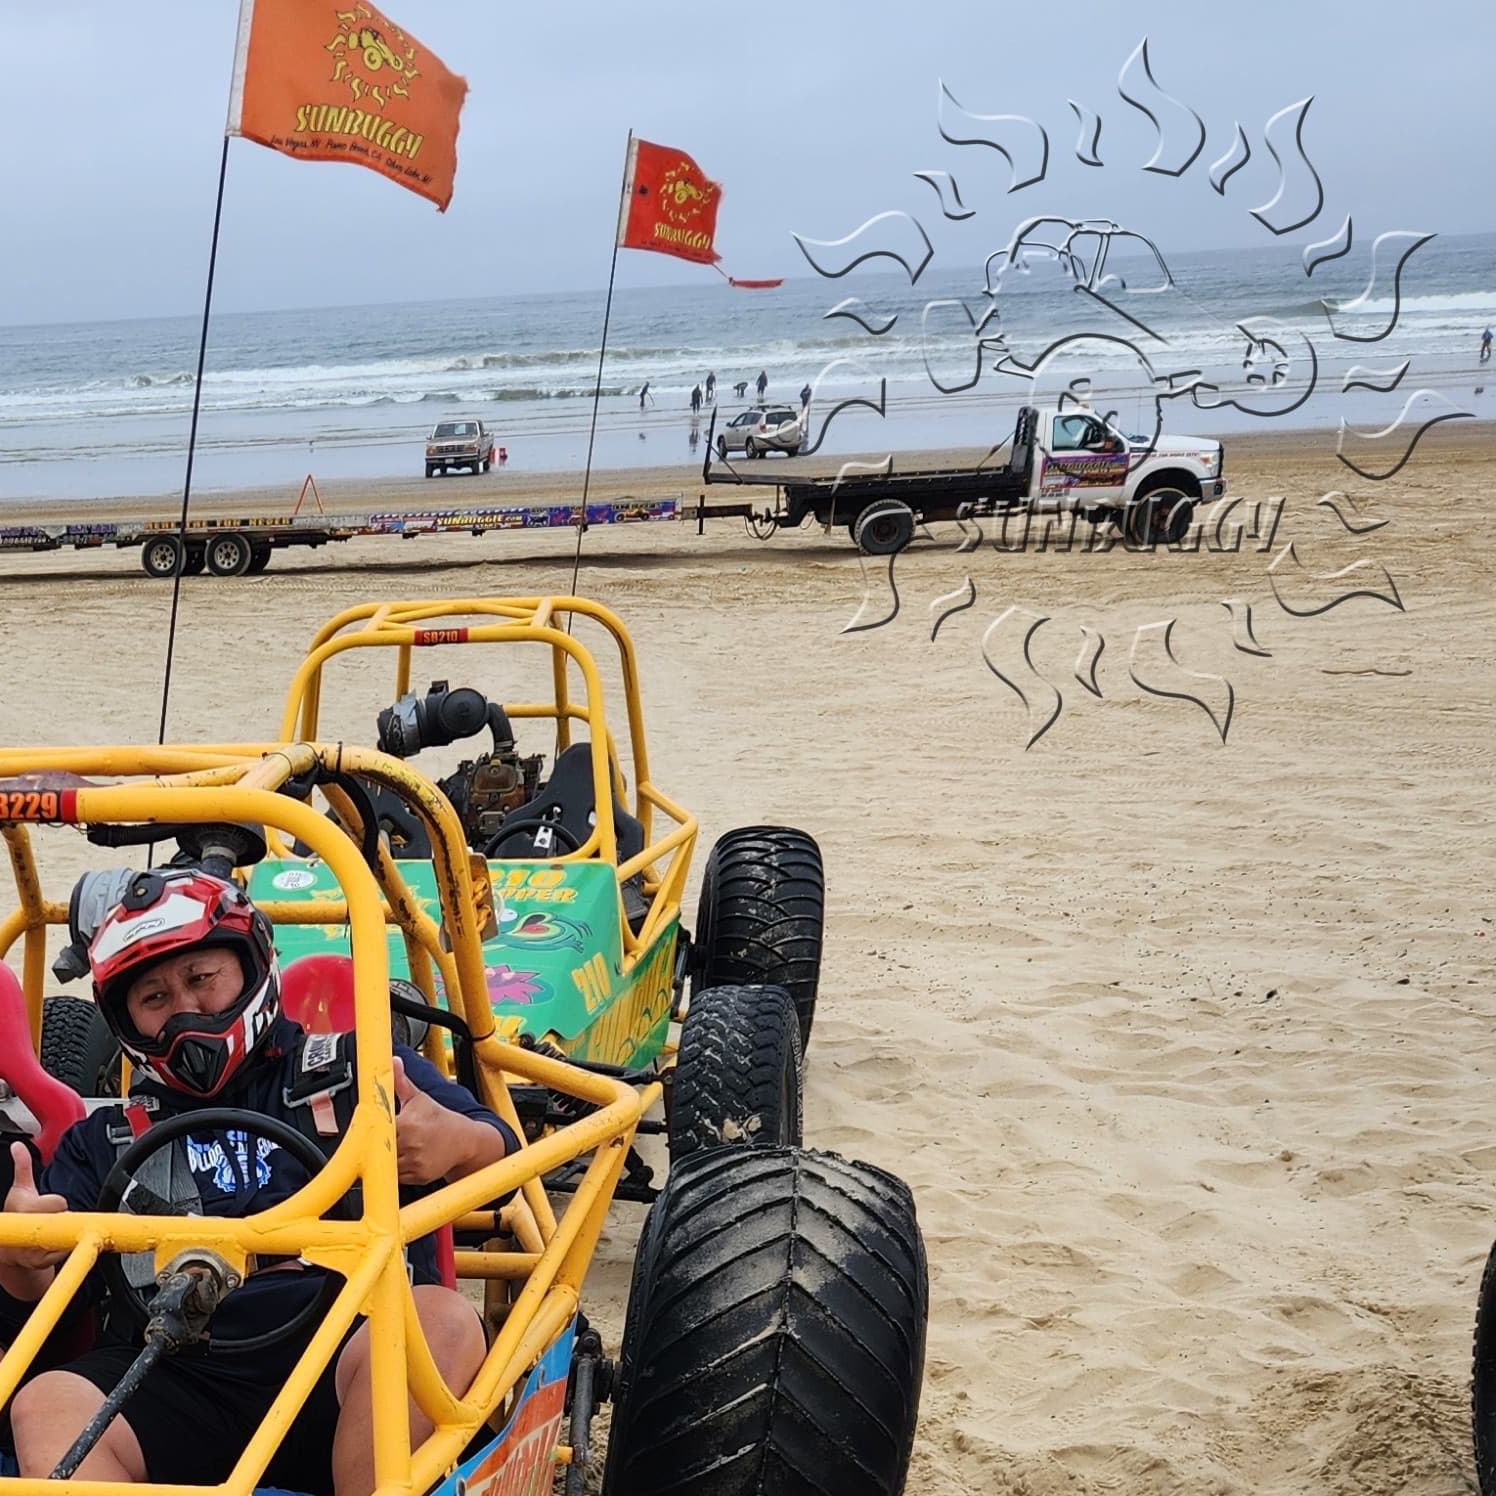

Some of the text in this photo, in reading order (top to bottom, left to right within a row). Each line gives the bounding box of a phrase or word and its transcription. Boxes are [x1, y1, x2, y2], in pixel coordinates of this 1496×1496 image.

[294, 104, 424, 160] SUNBUGGY
[654, 221, 711, 250] SUNBUGGY
[423, 631, 458, 643] SB210
[571, 952, 612, 1015] 210
